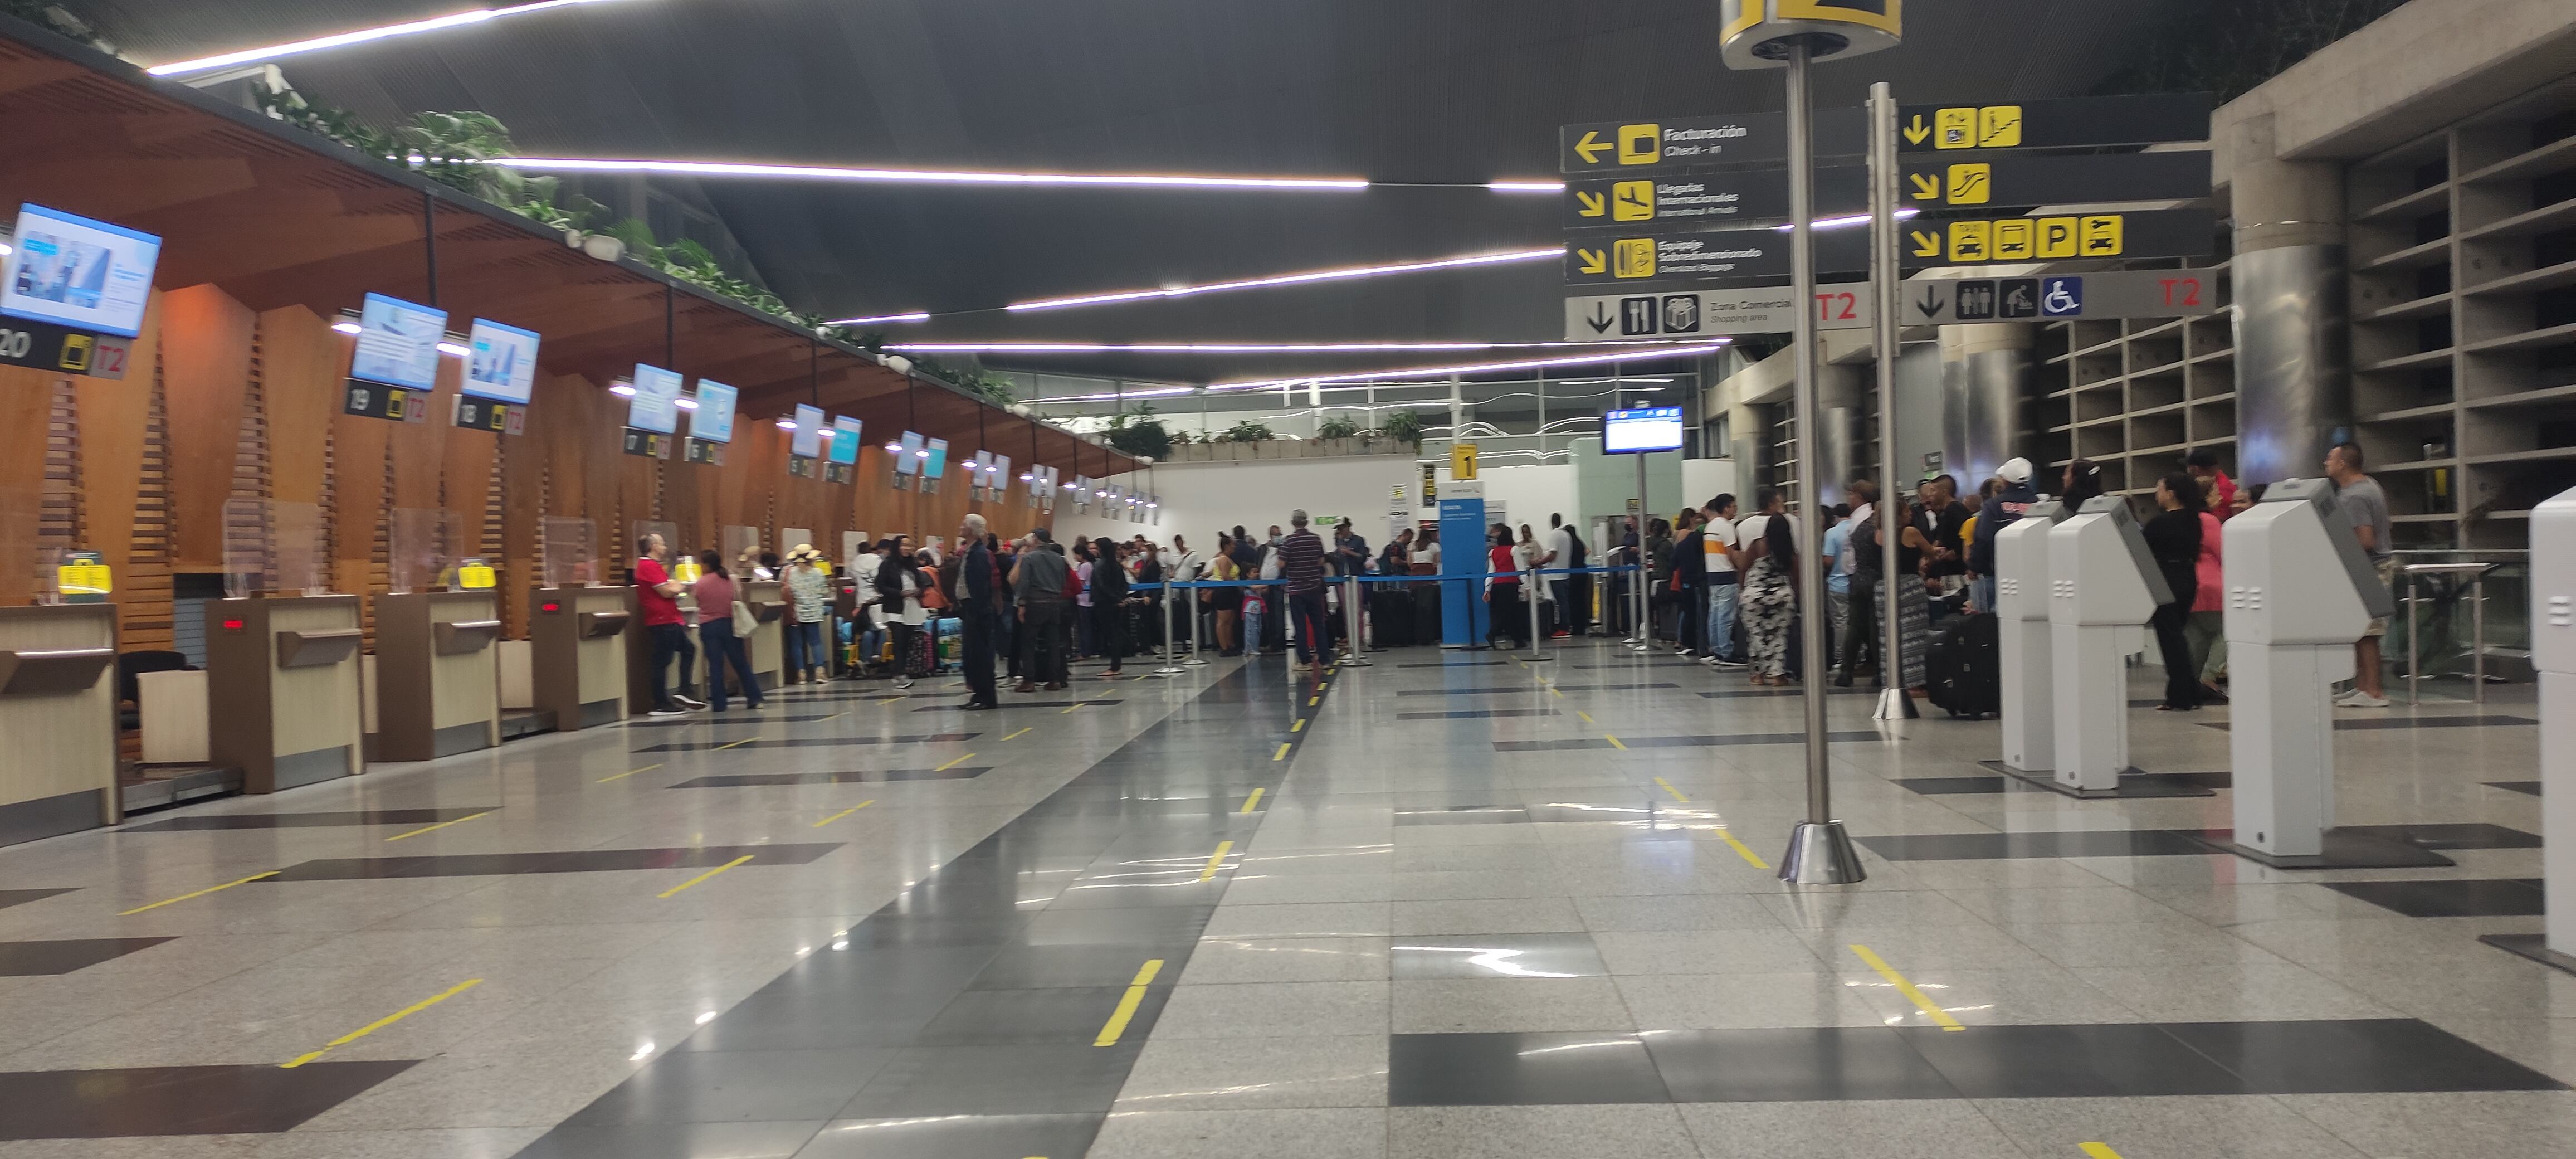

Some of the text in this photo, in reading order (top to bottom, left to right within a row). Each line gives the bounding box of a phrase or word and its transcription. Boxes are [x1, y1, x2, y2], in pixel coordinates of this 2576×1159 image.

[1664, 125, 1747, 141] Facturación
[2049, 225, 2066, 251] P
[2160, 279, 2201, 306] T2
[1711, 299, 1792, 311] Zona Comercial
[1815, 292, 1857, 322] T2
[1711, 313, 1768, 324] Shopping area
[97, 345, 125, 372] T2
[1463, 456, 1471, 477] 1
